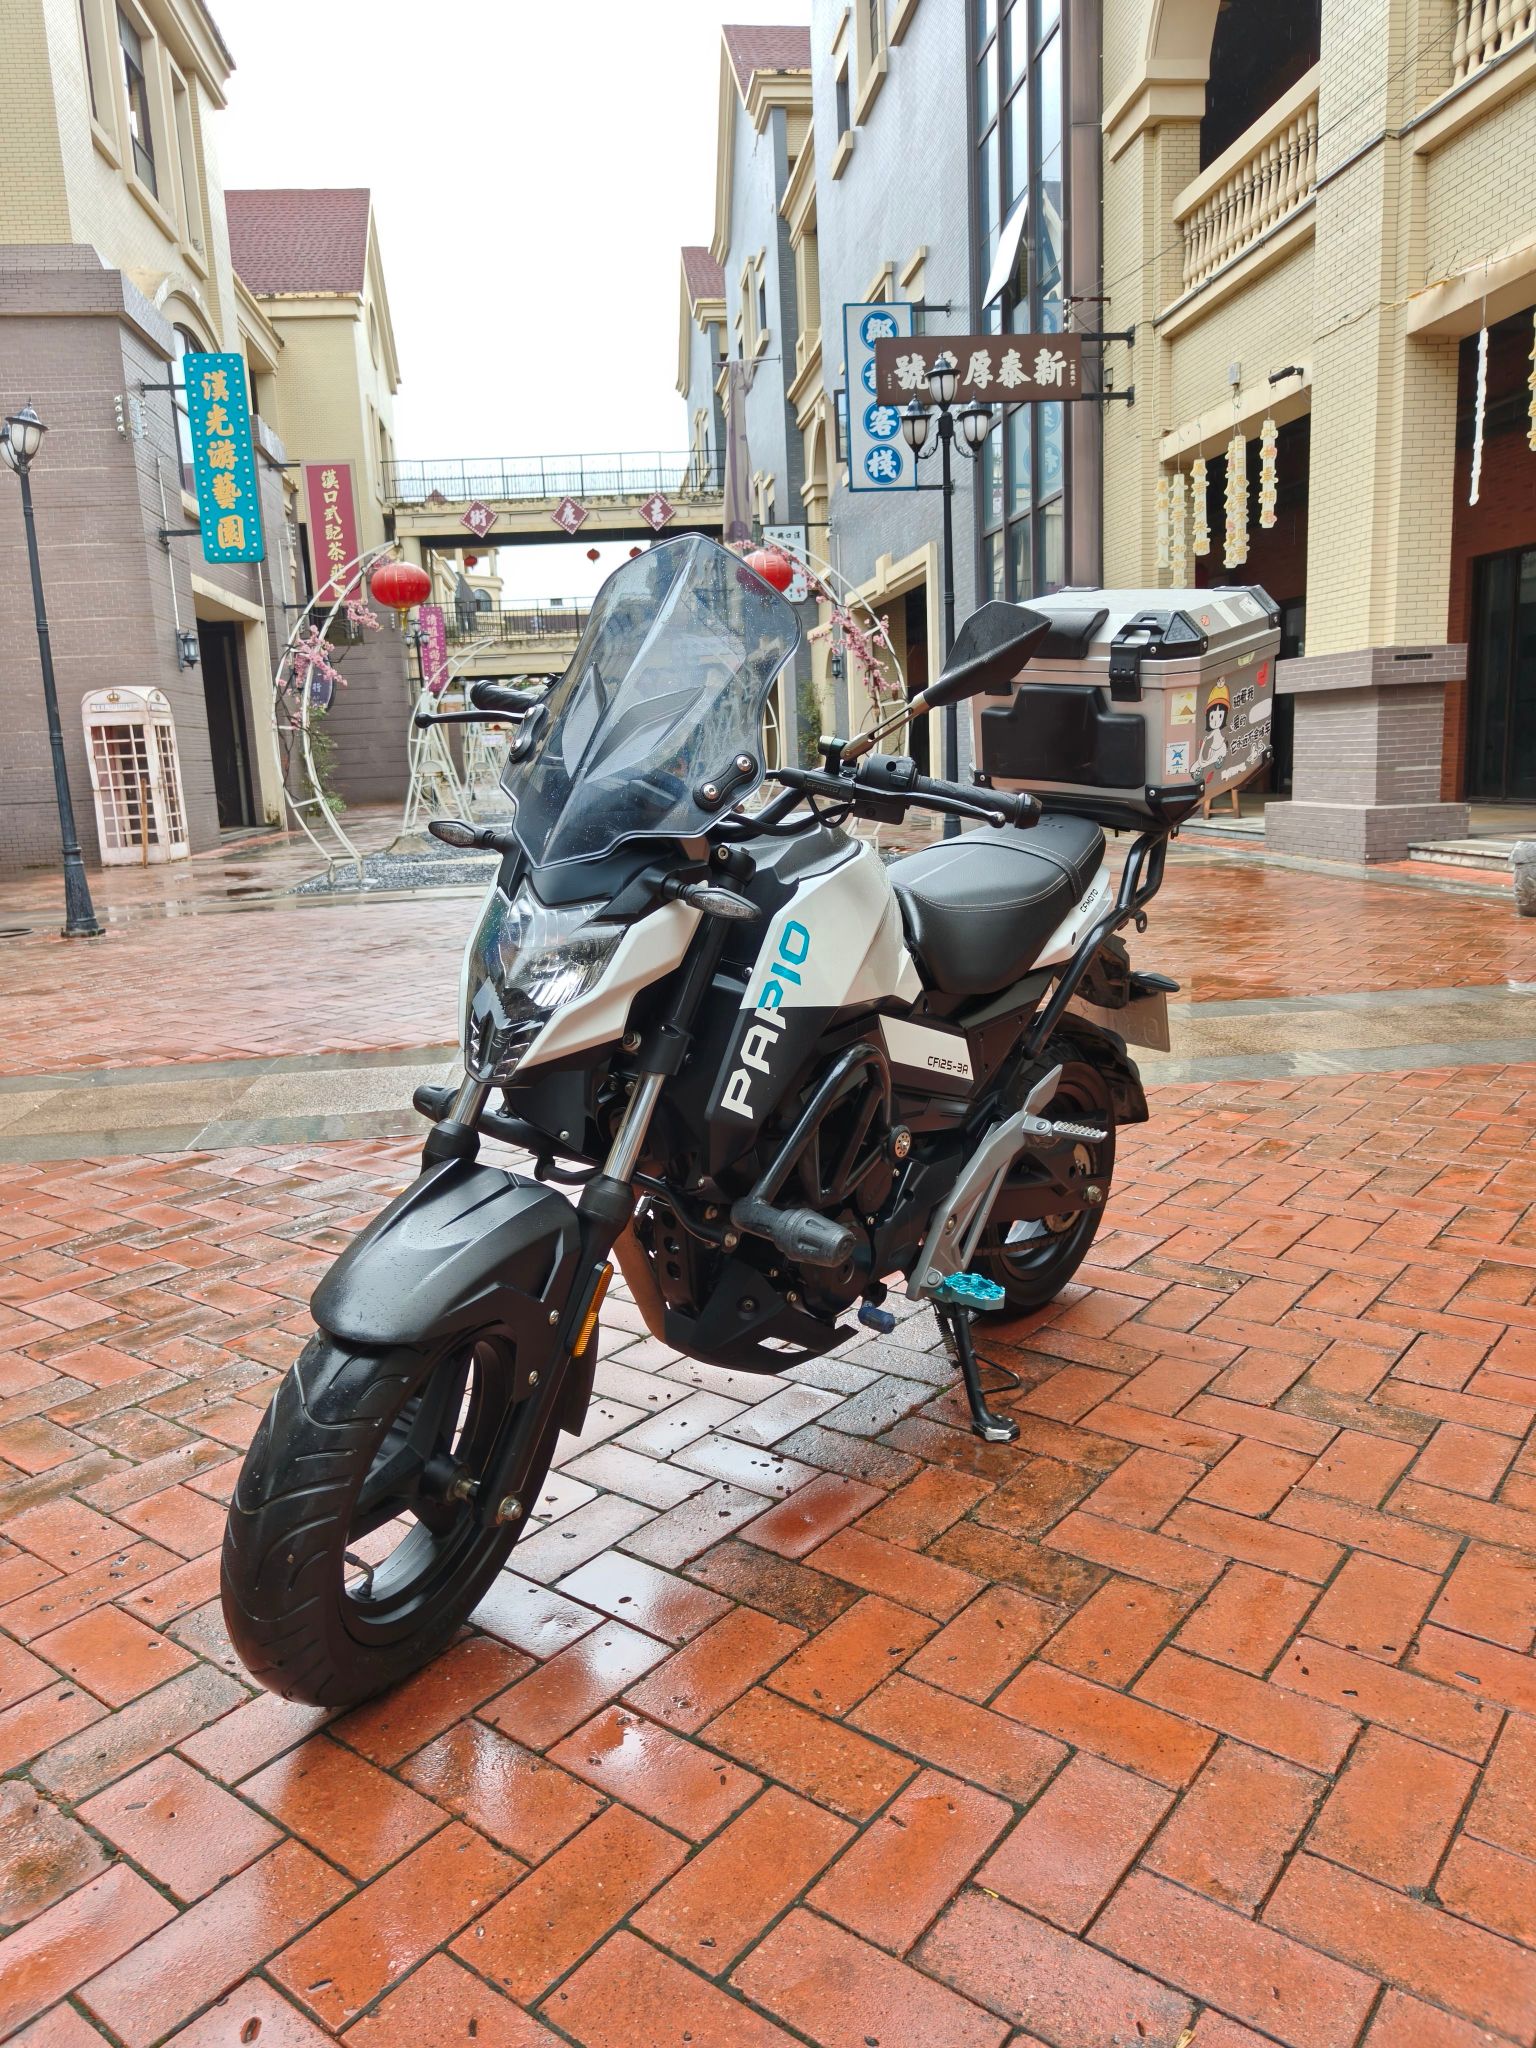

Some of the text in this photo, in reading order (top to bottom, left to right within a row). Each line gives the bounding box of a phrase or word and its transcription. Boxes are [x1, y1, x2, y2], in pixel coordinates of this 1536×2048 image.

[1080, 888, 1099, 913] CFMOTO
[720, 920, 811, 1120] PAPIO
[927, 1055, 969, 1075] CF125-3A
